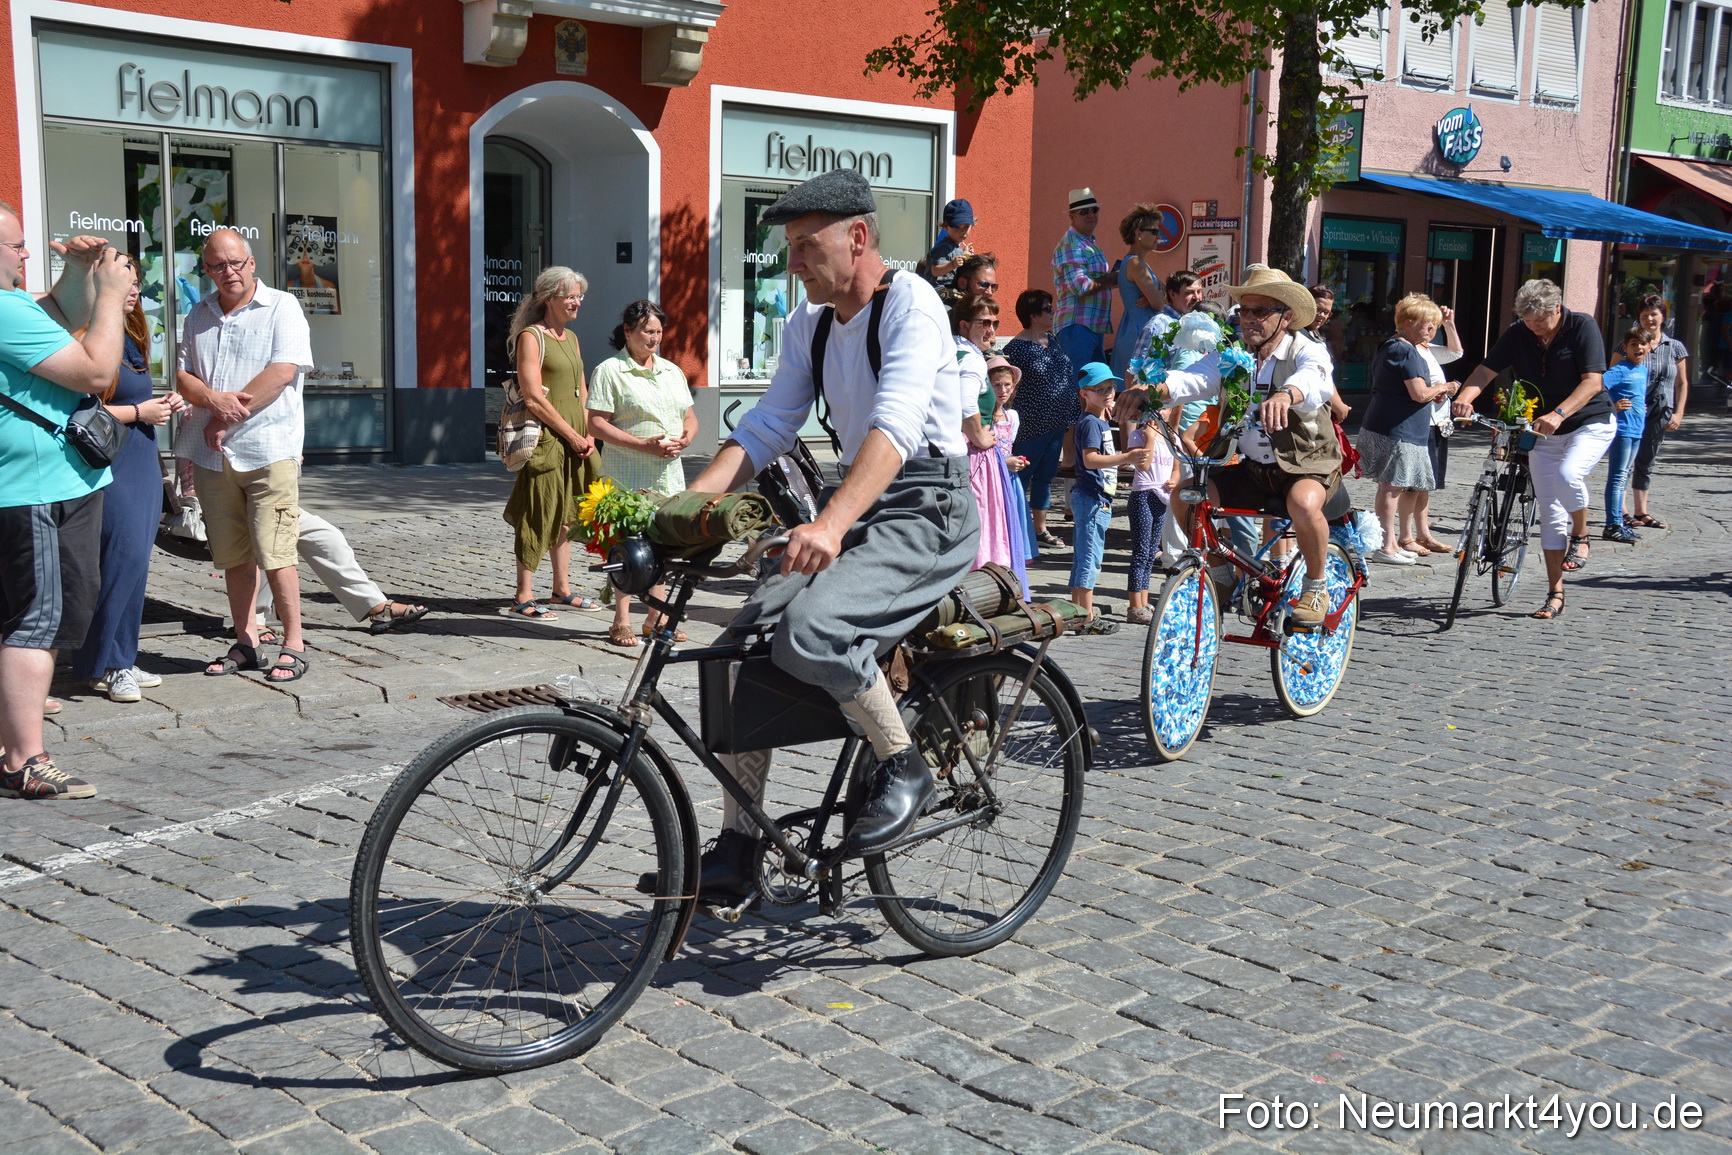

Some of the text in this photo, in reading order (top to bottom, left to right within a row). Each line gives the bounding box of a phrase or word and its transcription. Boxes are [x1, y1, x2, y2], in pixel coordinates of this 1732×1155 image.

[119, 62, 319, 128] fielmann
[1437, 113, 1464, 136] vom
[1325, 127, 1354, 147] ASS
[1443, 125, 1483, 158] FASS
[767, 131, 893, 178] fielmann
[70, 210, 145, 233] fielmann
[1323, 226, 1400, 248] Spirituosen Whisky
[1438, 239, 1468, 252] Feinkost
[1526, 241, 1543, 256] Essig
[484, 255, 522, 270] lmann
[484, 271, 522, 286] lmann
[484, 287, 522, 302] lmann
